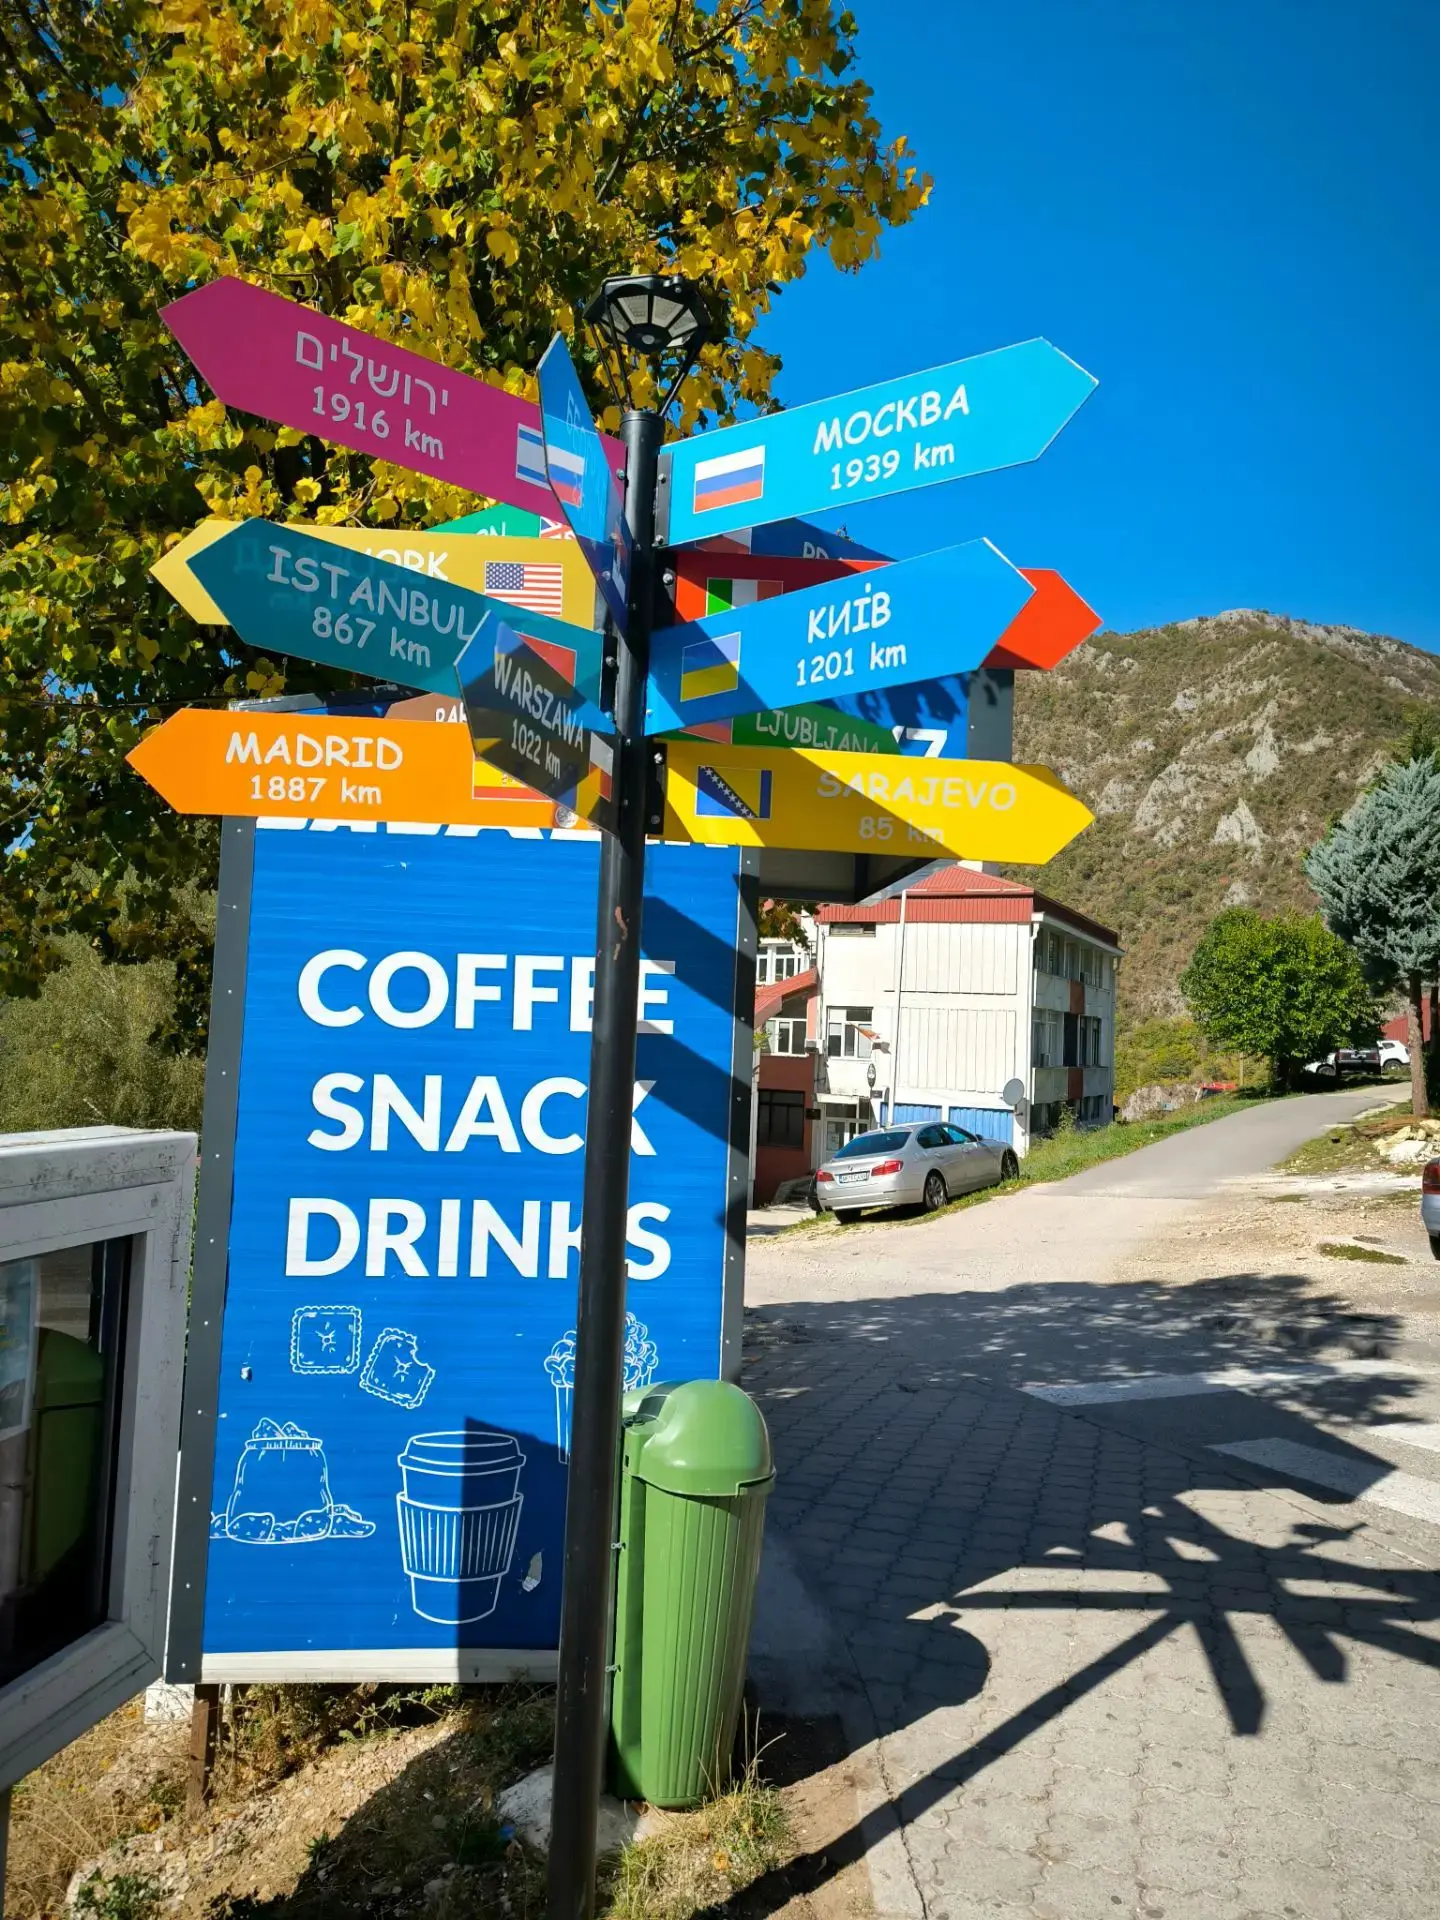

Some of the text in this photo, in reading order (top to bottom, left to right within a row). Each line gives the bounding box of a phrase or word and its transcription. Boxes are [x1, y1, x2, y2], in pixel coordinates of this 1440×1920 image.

[296, 331, 449, 416] ירושלים
[312, 386, 444, 461] 1916 km
[813, 384, 970, 456] МОСКВА
[830, 442, 955, 491] 1939 km
[266, 544, 472, 642] ISTANBUL
[311, 606, 431, 669] 867 km
[796, 641, 907, 688] 1201 km
[493, 645, 585, 753] WARSZAWA
[225, 731, 404, 771] MADRID
[511, 718, 562, 780] 1022 km
[250, 774, 382, 805] 1887 km
[816, 769, 1018, 812] SARAJEVO
[858, 815, 946, 845] 85 km
